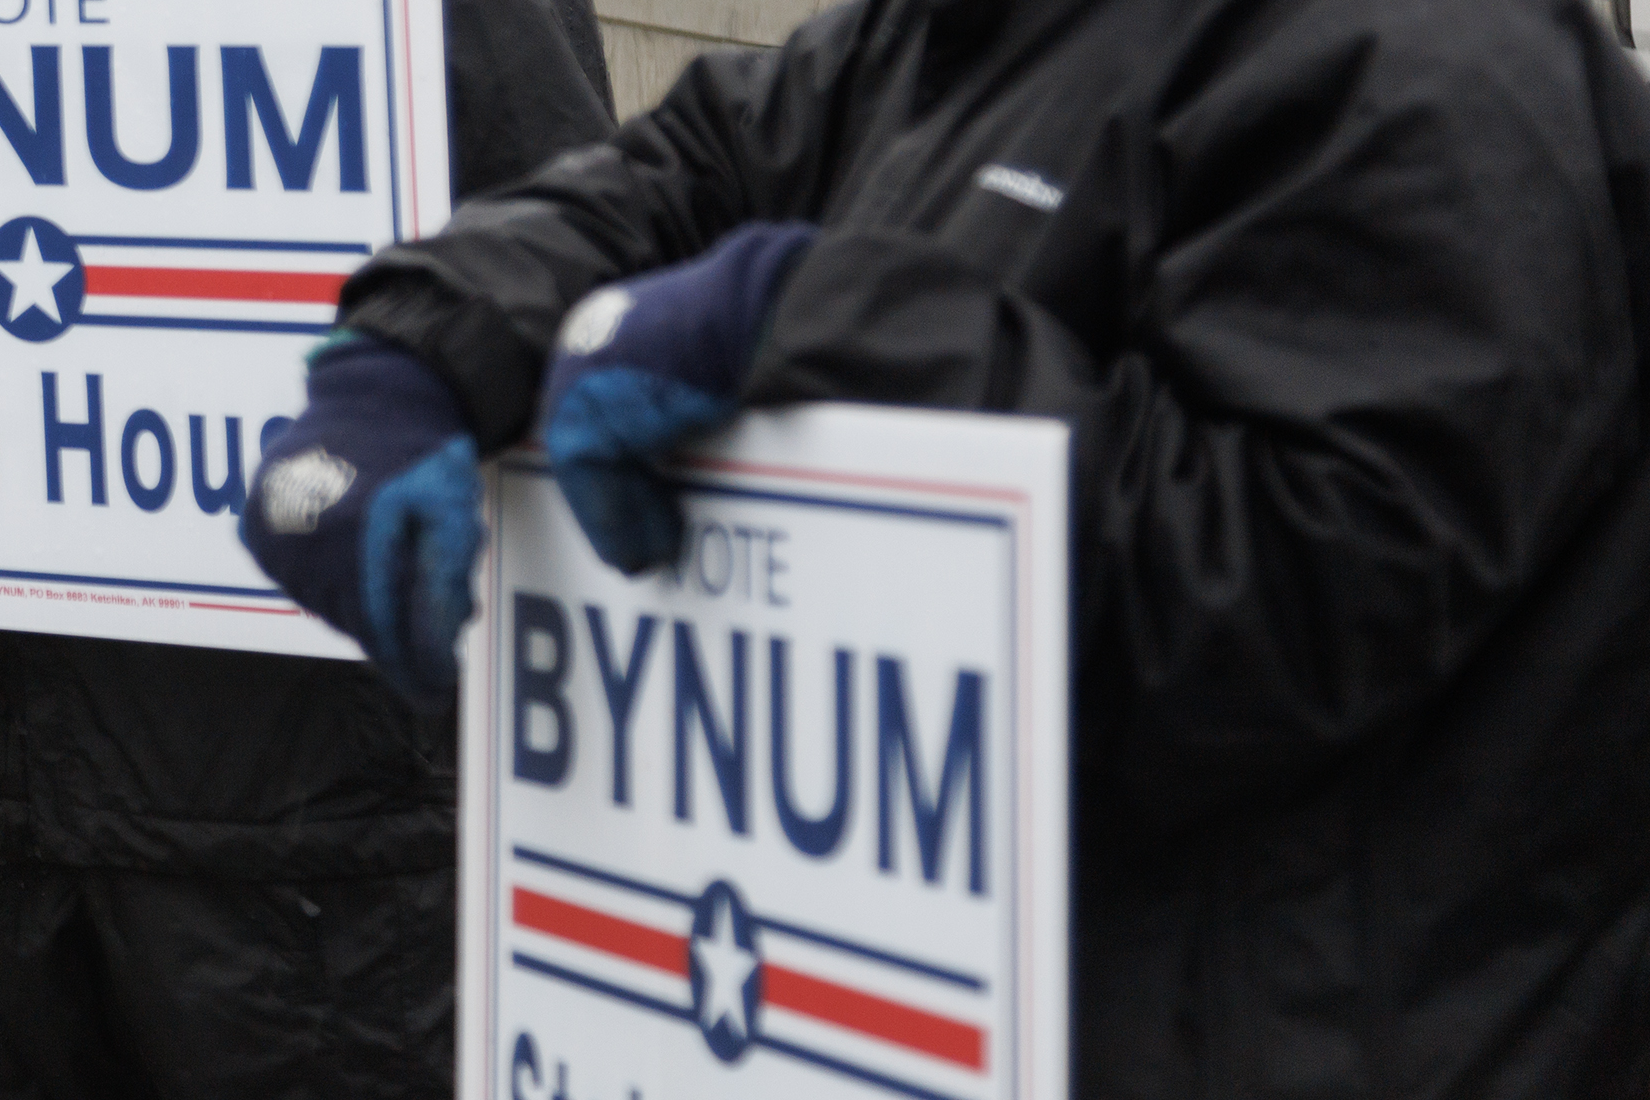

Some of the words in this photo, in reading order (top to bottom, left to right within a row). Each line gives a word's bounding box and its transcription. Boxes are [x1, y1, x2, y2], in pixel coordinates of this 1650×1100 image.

[40, 371, 298, 516] Hou
[30, 588, 44, 600] PO
[46, 589, 64, 601] Box
[90, 592, 140, 608] Ketchikan,
[142, 597, 156, 608] AK
[675, 522, 791, 607] OTE
[511, 590, 991, 899] BYNUM
